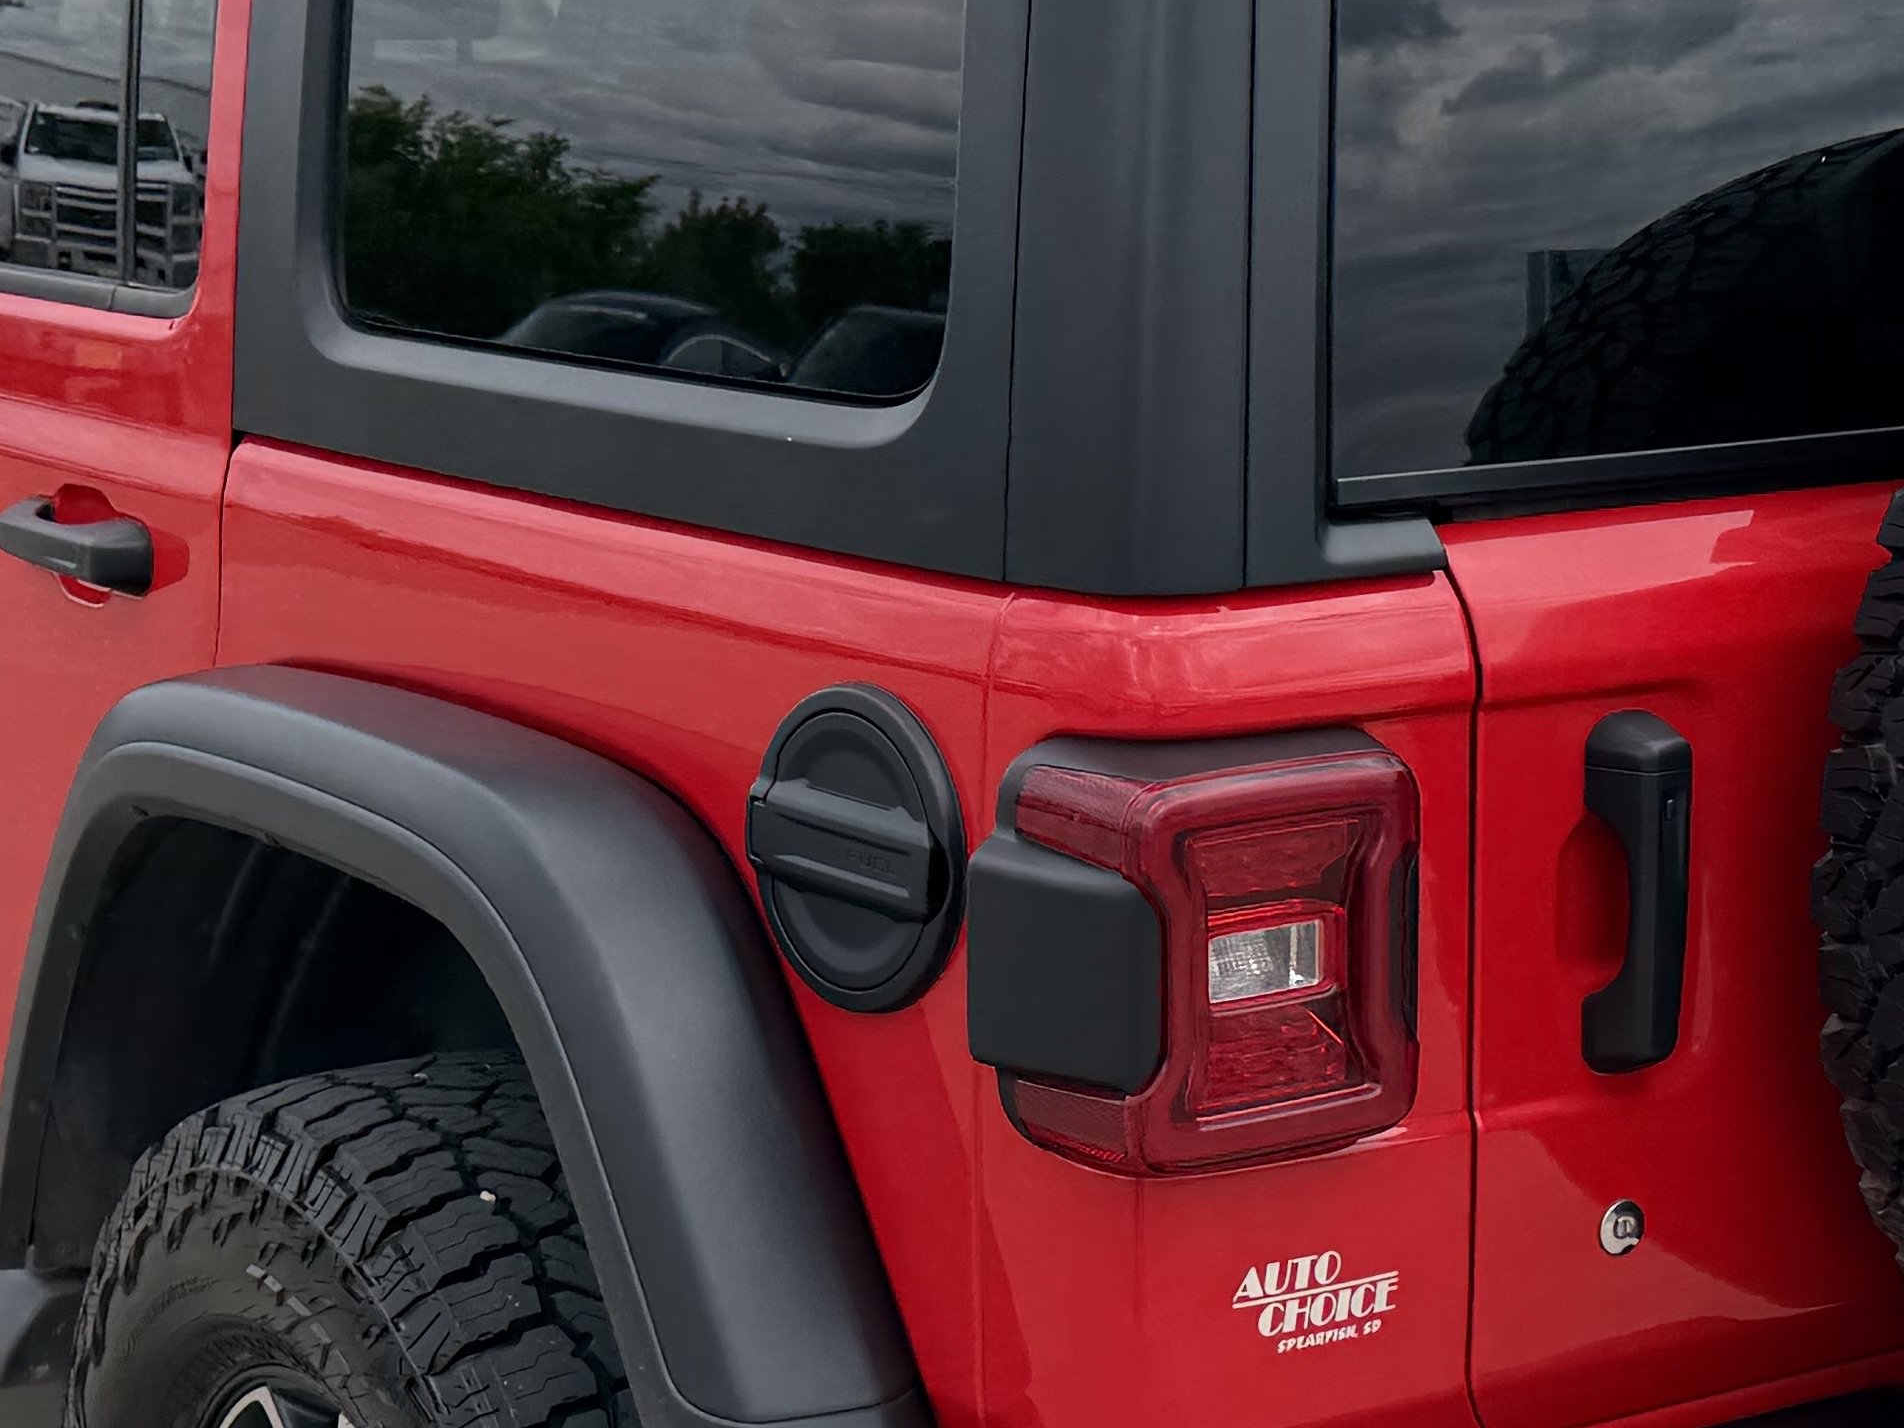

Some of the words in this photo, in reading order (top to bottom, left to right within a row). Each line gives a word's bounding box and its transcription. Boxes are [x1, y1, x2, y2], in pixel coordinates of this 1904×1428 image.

[1232, 1250, 1342, 1303] AUTO
[1257, 1276, 1400, 1338] CHOICE
[1362, 1318, 1383, 1337] SD
